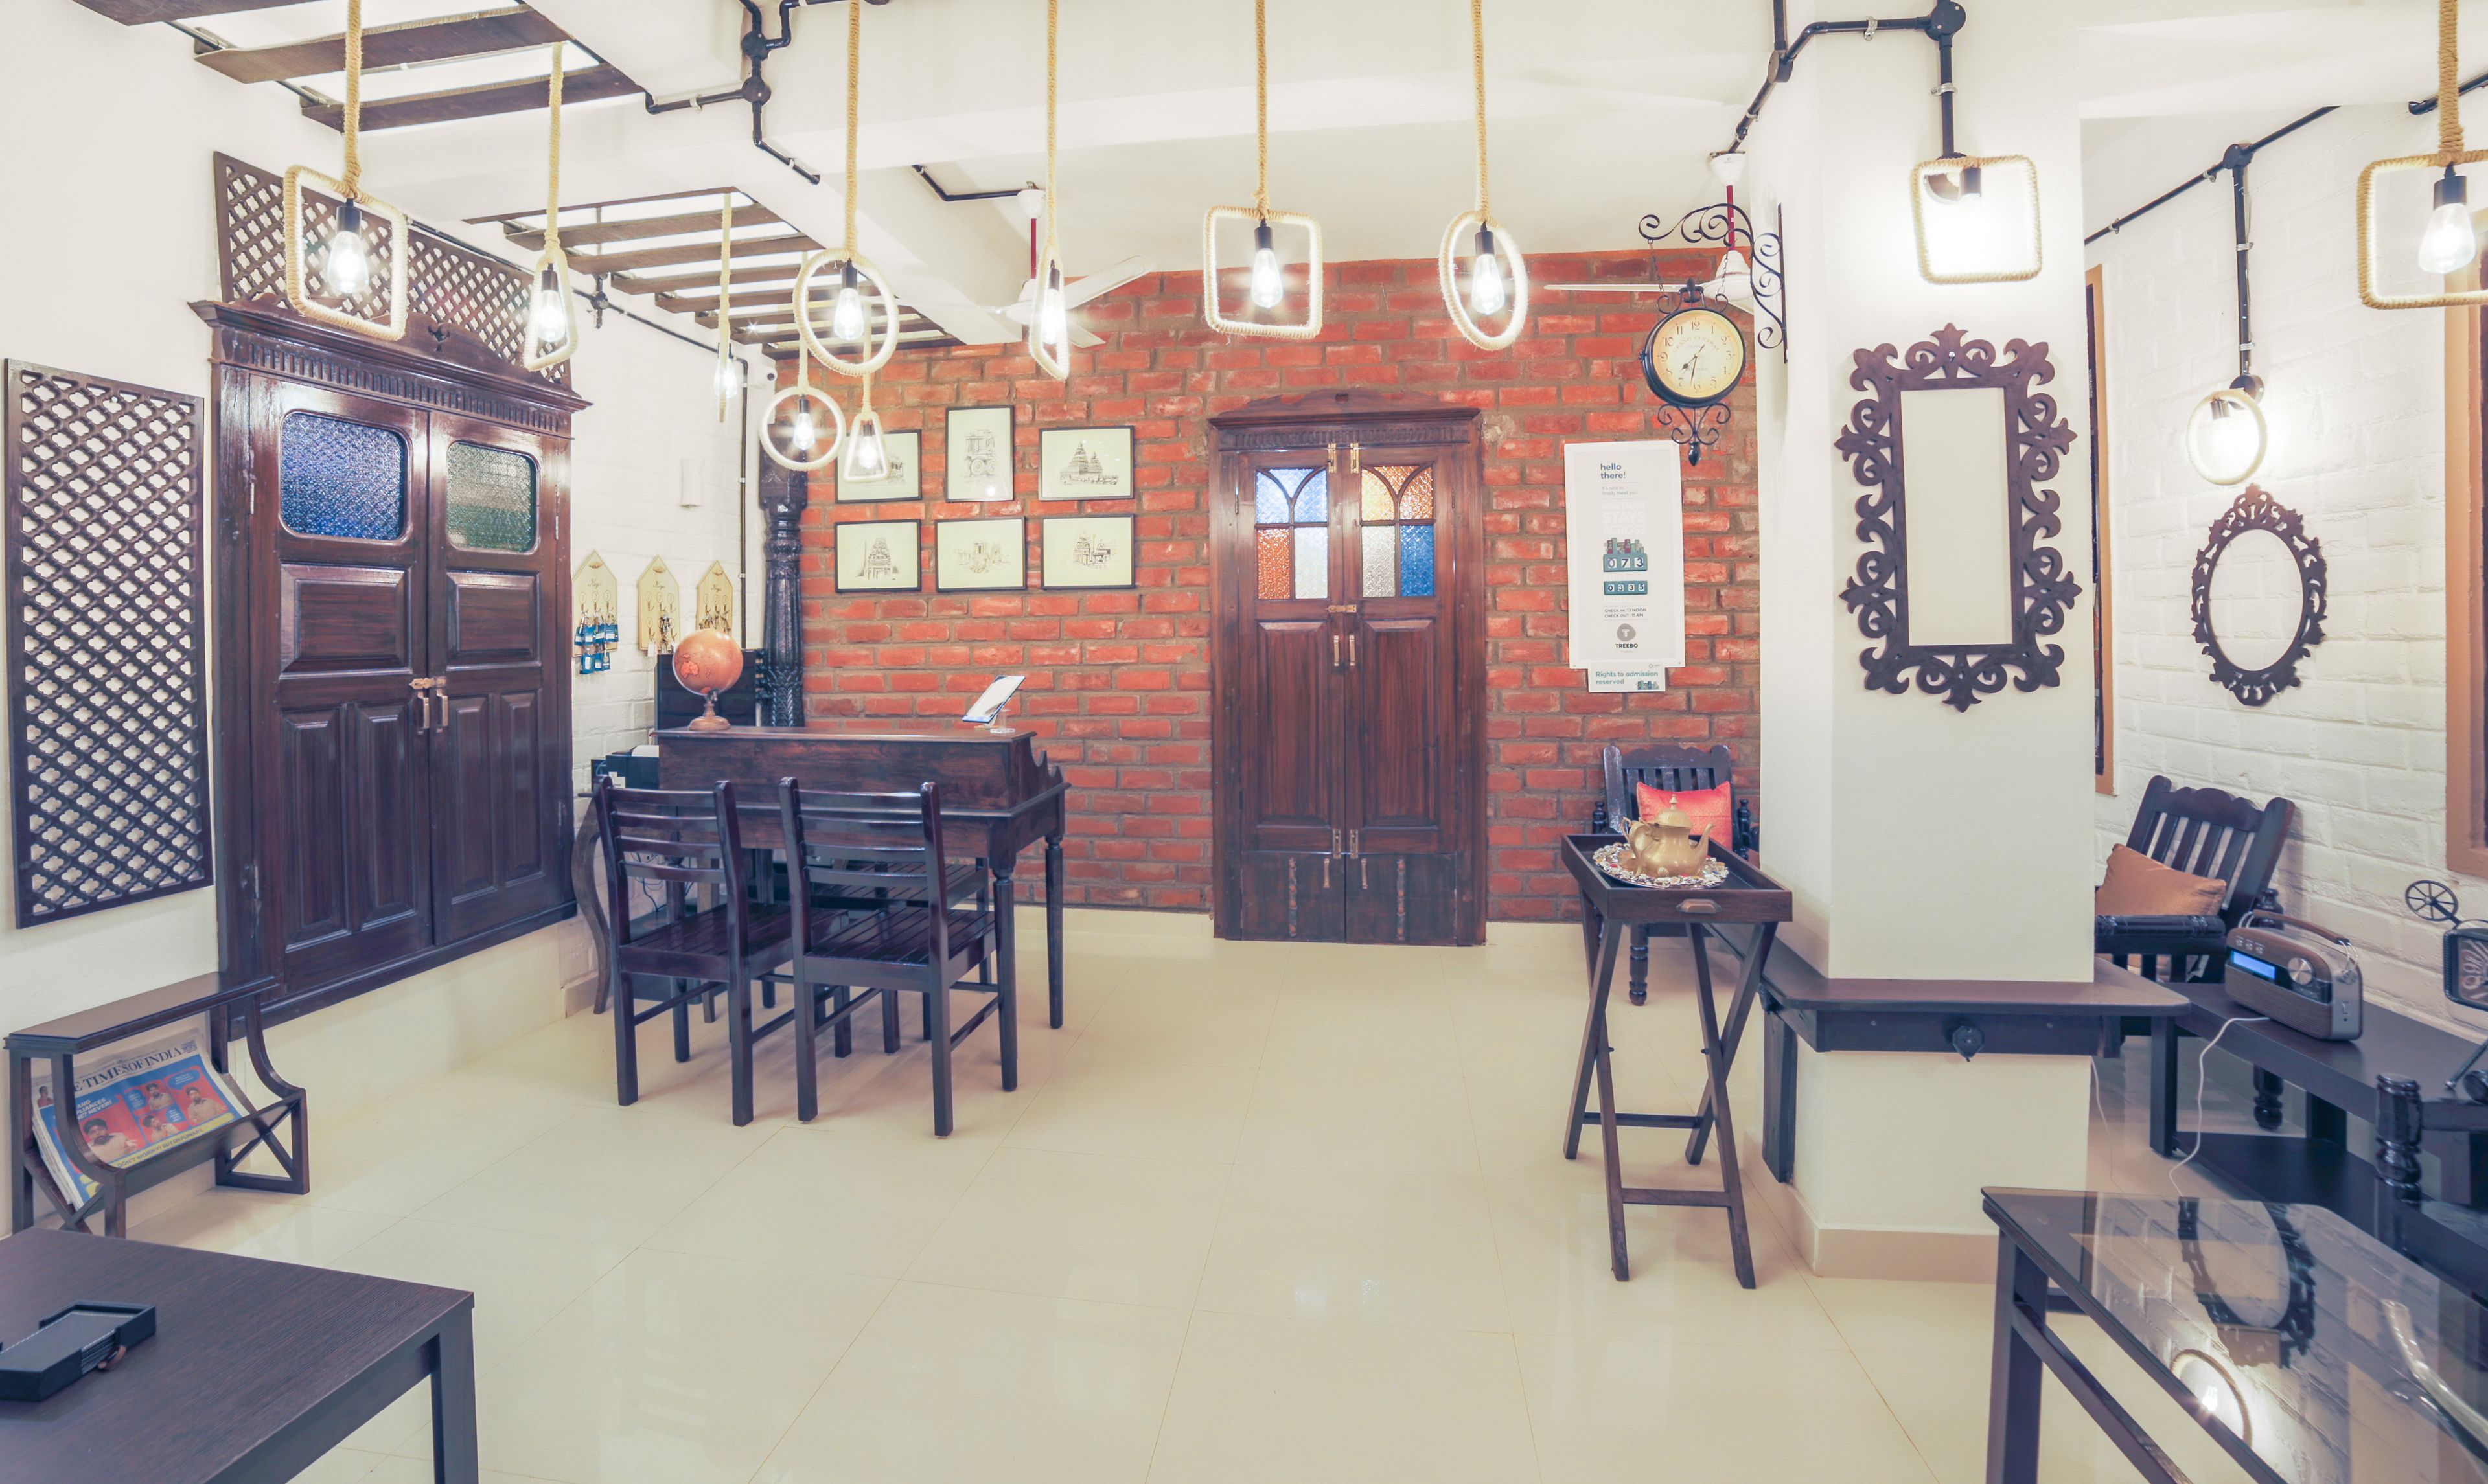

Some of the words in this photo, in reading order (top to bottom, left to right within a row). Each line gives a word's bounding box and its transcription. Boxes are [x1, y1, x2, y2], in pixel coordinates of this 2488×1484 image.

[1677, 326, 1683, 335] 11
[1692, 321, 1700, 330] 12
[1665, 337, 1674, 347] 10
[1660, 352, 1668, 361] 9
[1678, 378, 1683, 387] 7
[1710, 377, 1717, 388] 5
[83, 1066, 129, 1088] TIMES
[129, 1059, 143, 1072] OF
[144, 1047, 183, 1066] INDIA
[76, 1099, 91, 1109] AND
[88, 1100, 112, 1115] NEVER!
